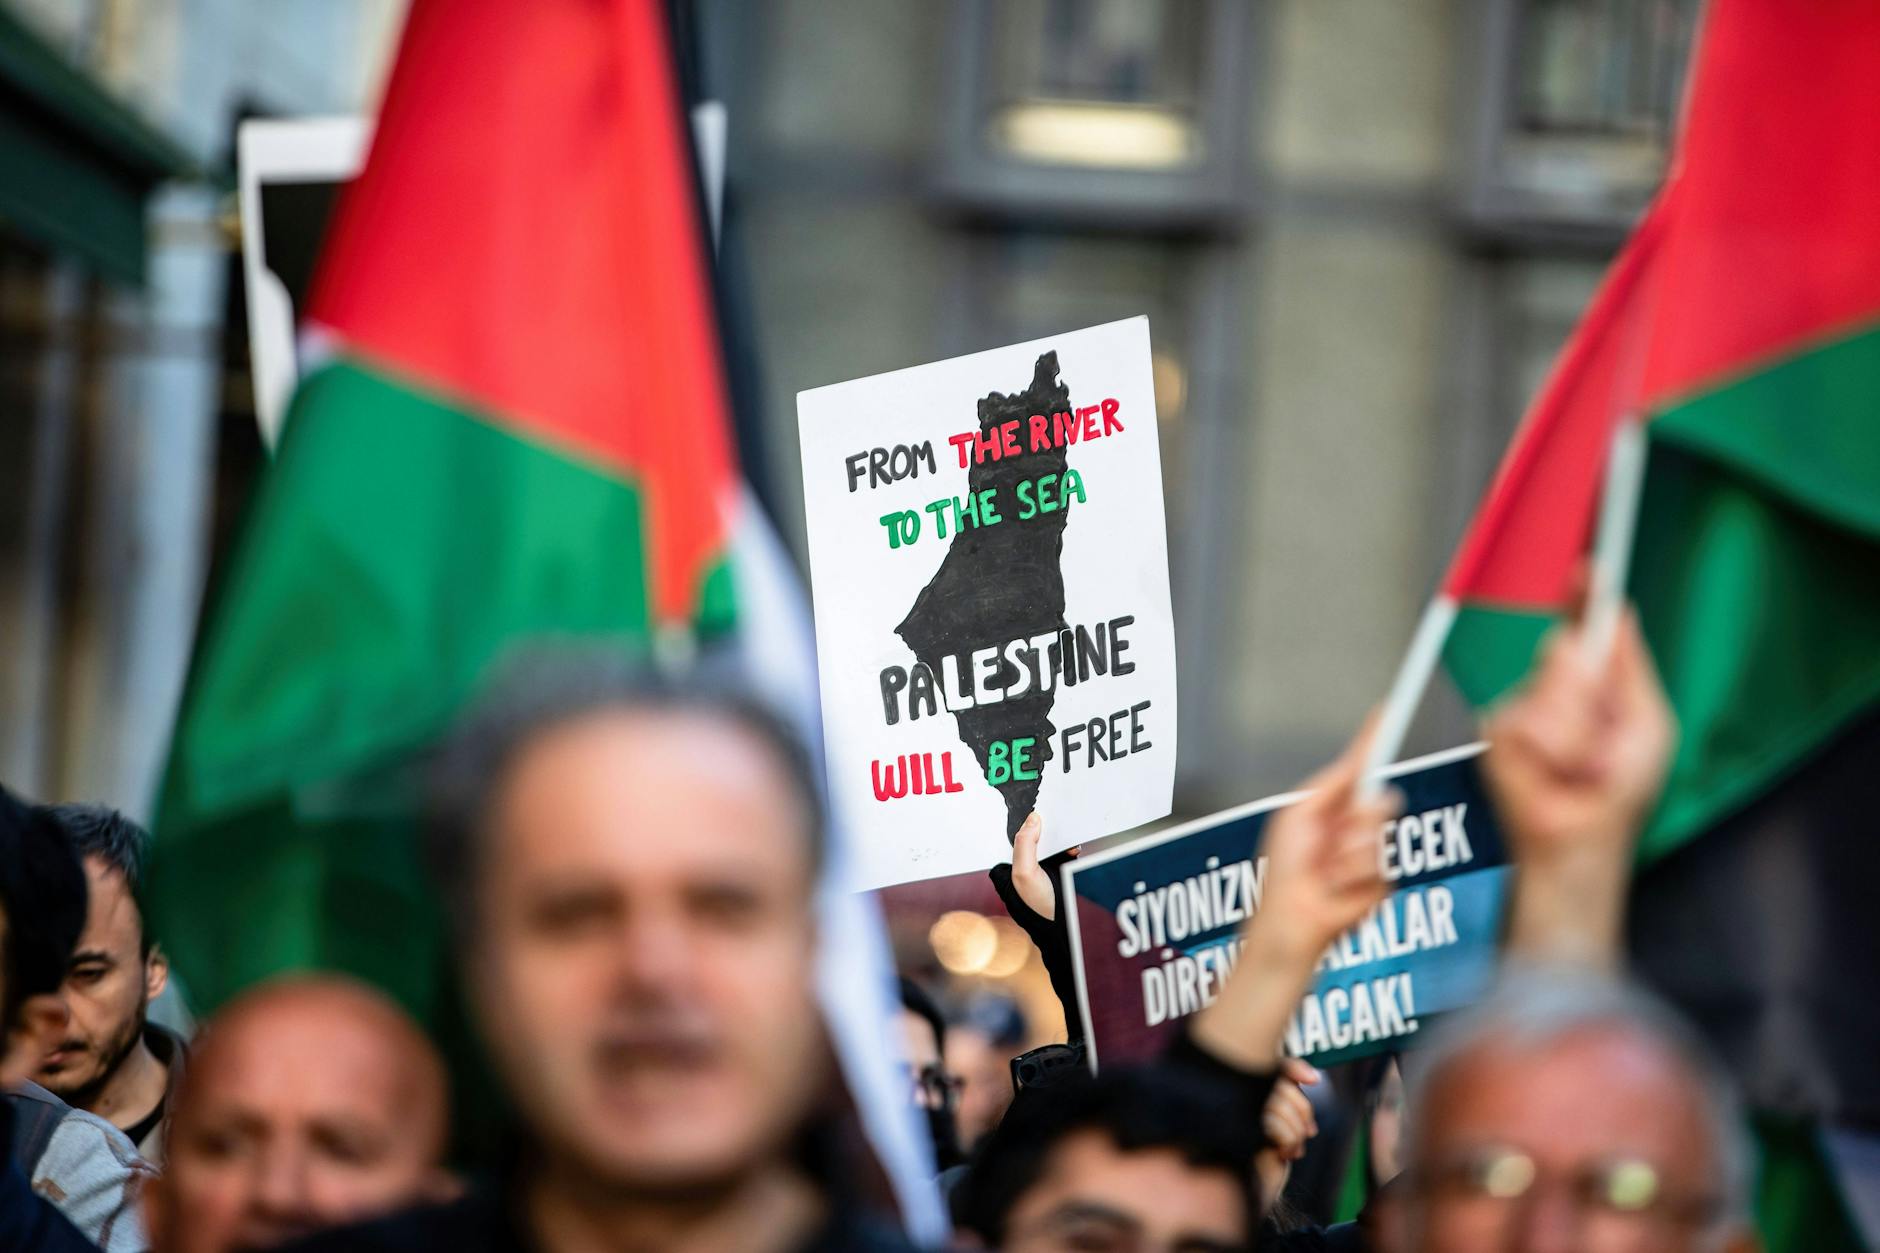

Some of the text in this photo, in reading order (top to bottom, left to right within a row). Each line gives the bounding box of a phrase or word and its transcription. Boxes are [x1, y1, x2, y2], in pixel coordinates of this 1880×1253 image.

[845, 398, 1125, 492] FROM THE RIVER
[879, 469, 1087, 549] TO THE SEA
[879, 615, 1136, 725] PALESTINE
[871, 700, 1152, 802] WILL BE FREE
[1377, 802, 1474, 882] ECEK
[1141, 885, 1459, 1027] DİREN ALKLAR
